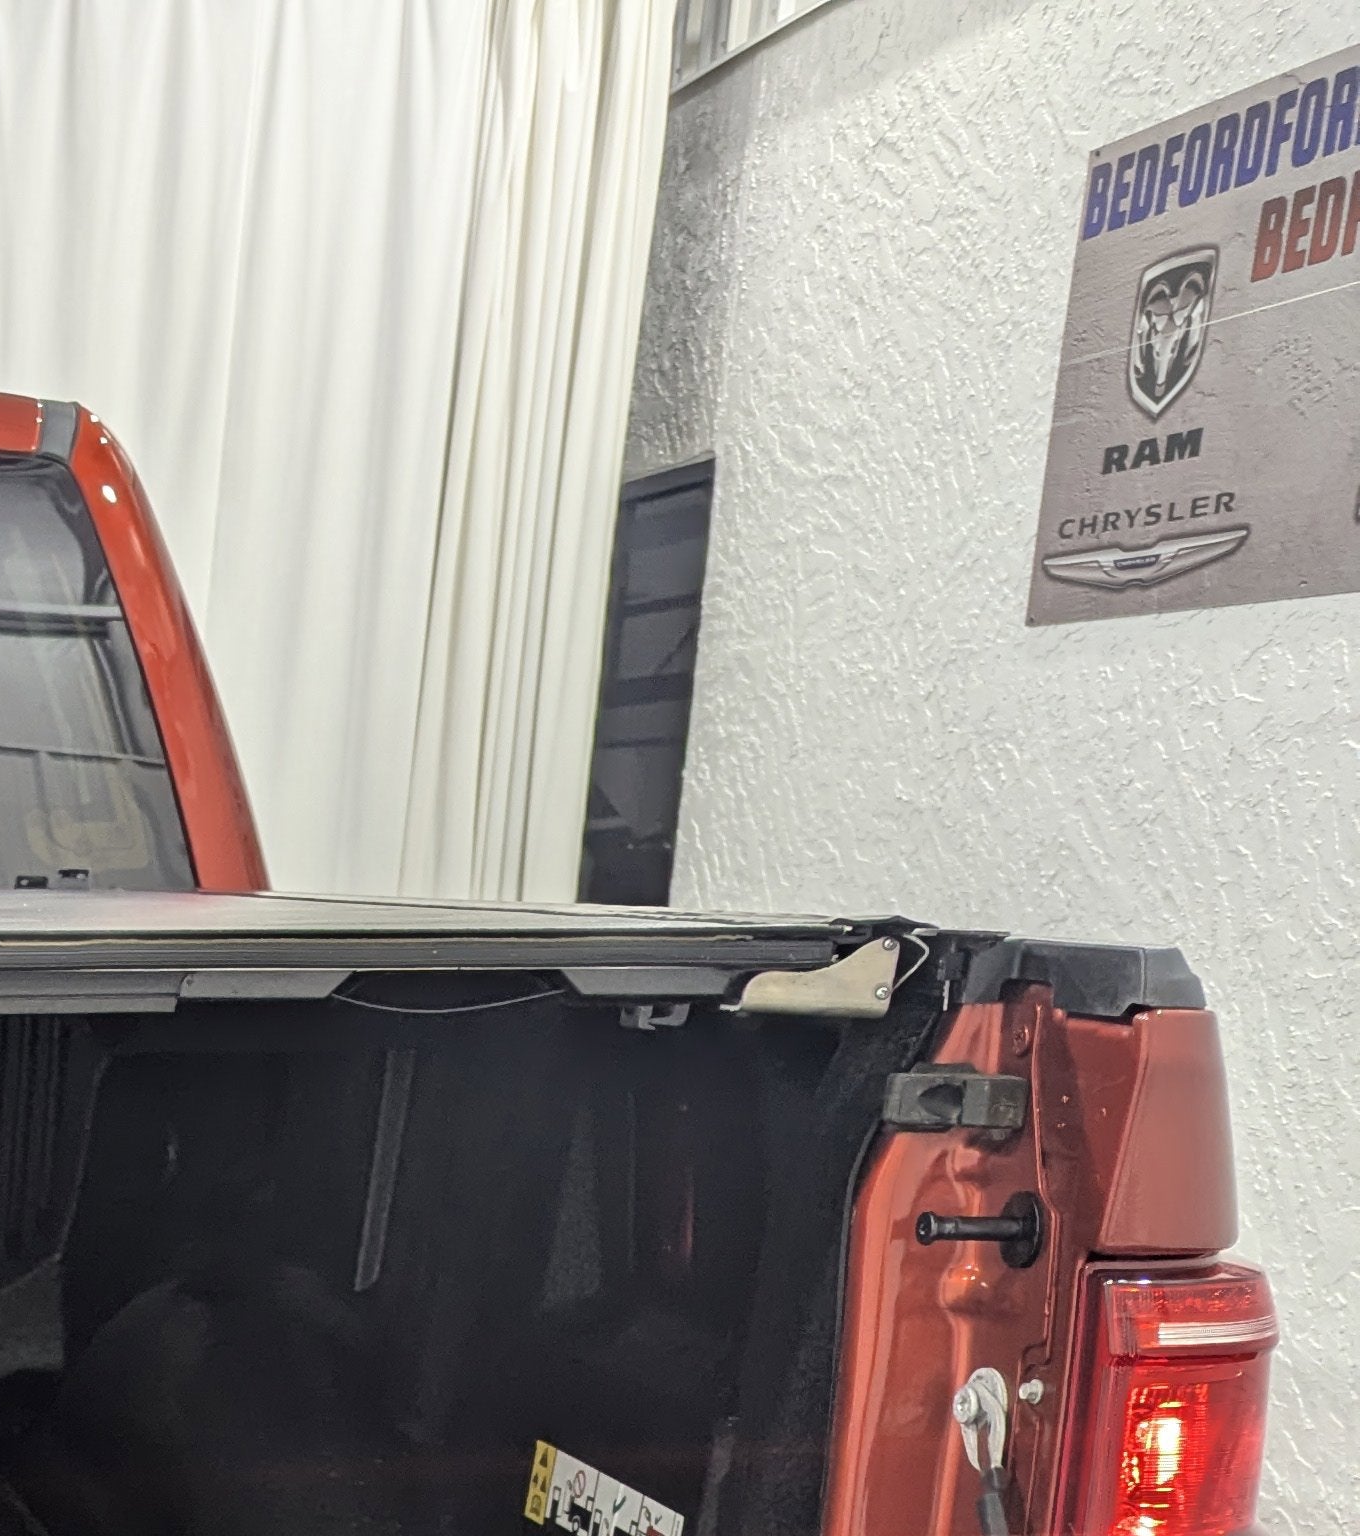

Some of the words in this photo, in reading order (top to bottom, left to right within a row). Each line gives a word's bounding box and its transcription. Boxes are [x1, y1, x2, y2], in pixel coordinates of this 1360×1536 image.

[1082, 65, 1360, 241] BEDFORDFOR
[1101, 427, 1204, 475] RAM
[1058, 492, 1235, 539] CHRYSLER
